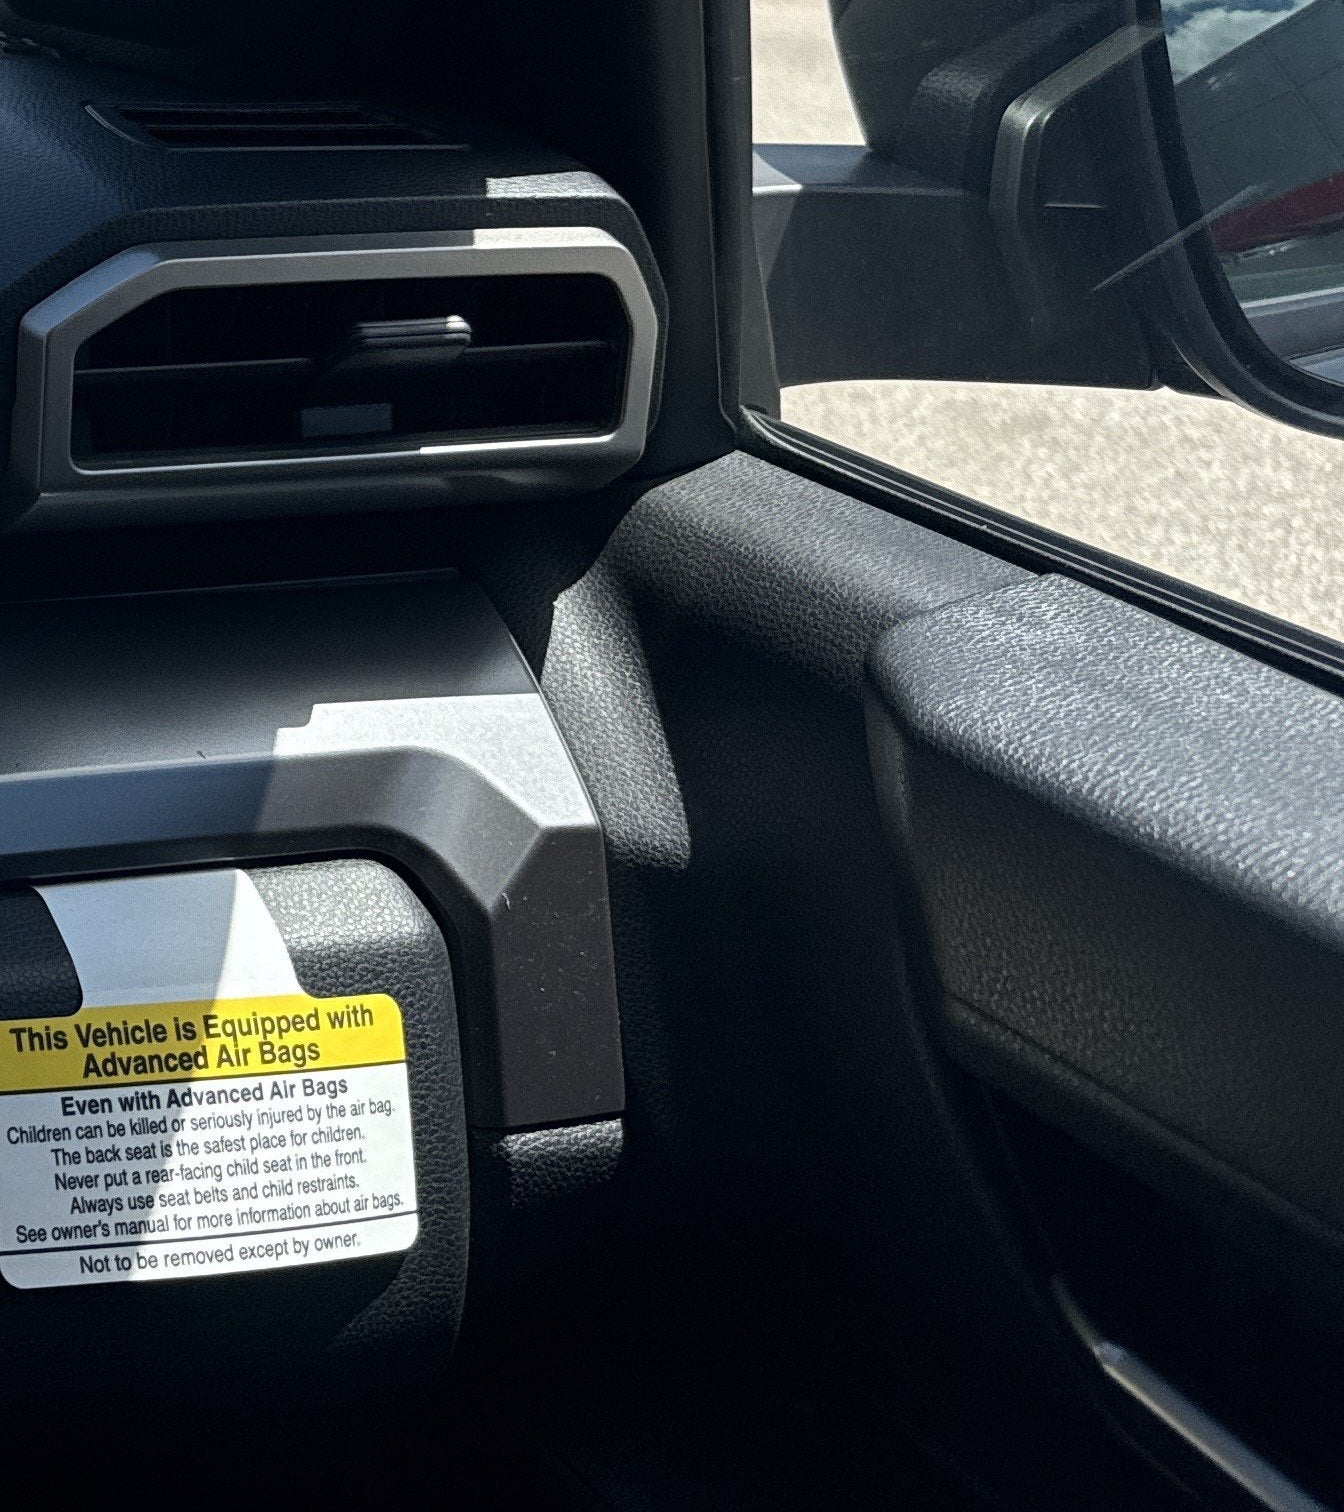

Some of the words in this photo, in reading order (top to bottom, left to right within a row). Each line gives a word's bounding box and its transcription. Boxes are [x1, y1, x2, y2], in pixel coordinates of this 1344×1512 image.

[9, 1026, 68, 1052] This
[74, 1019, 167, 1048] Vehicle
[174, 1017, 196, 1041] is
[203, 1007, 320, 1043] Equipped
[327, 1004, 373, 1029] with
[83, 1045, 208, 1078] Advanced
[217, 1044, 251, 1068] Air
[259, 1041, 320, 1067] Bags
[61, 1096, 112, 1116] Even
[118, 1090, 161, 1112] with
[166, 1082, 263, 1108] Advanced
[270, 1081, 296, 1100] Air
[302, 1078, 348, 1099] Bags
[7, 1125, 71, 1144] Children
[76, 1123, 102, 1140] can
[107, 1120, 125, 1137] be
[130, 1117, 167, 1135] killed
[172, 1118, 185, 1132] or
[191, 1109, 252, 1131] seriously
[257, 1103, 302, 1129] injured
[307, 1104, 322, 1124] by
[326, 1102, 346, 1120] the
[351, 1099, 365, 1116] air
[369, 1098, 395, 1116] bag.
[51, 1148, 81, 1166] The
[86, 1144, 121, 1163] back
[125, 1142, 156, 1161] seat
[161, 1141, 172, 1158] is
[176, 1139, 199, 1156] the
[204, 1135, 245, 1154] safest
[250, 1132, 286, 1154] place
[290, 1129, 307, 1147] for
[312, 1125, 365, 1144] children.
[54, 1172, 99, 1190] Never
[104, 1169, 128, 1191] put
[132, 1170, 142, 1185] a
[146, 1162, 222, 1184] rear-facing
[227, 1158, 259, 1177] child
[263, 1156, 292, 1173] seat
[296, 1154, 307, 1170] in
[311, 1152, 331, 1169] the
[335, 1148, 367, 1165] front.
[70, 1196, 123, 1216] Always
[128, 1194, 154, 1210] use
[158, 1190, 190, 1207] seat
[194, 1186, 228, 1205] belts
[233, 1182, 258, 1201] and
[262, 1178, 293, 1197] child
[297, 1173, 359, 1193] restraints.
[16, 1224, 46, 1243] See
[52, 1220, 110, 1241] owner's
[115, 1215, 169, 1237] manual
[174, 1214, 192, 1231] for
[197, 1211, 233, 1228] more
[237, 1203, 311, 1225] information
[315, 1198, 350, 1216] about
[354, 1194, 368, 1211] air
[372, 1192, 404, 1210] bags.
[79, 1256, 111, 1274] Not
[115, 1254, 131, 1271] to
[137, 1252, 158, 1269] be
[164, 1244, 234, 1266] removed
[239, 1240, 289, 1260] except
[293, 1237, 309, 1257] by
[315, 1233, 361, 1251] owner.
